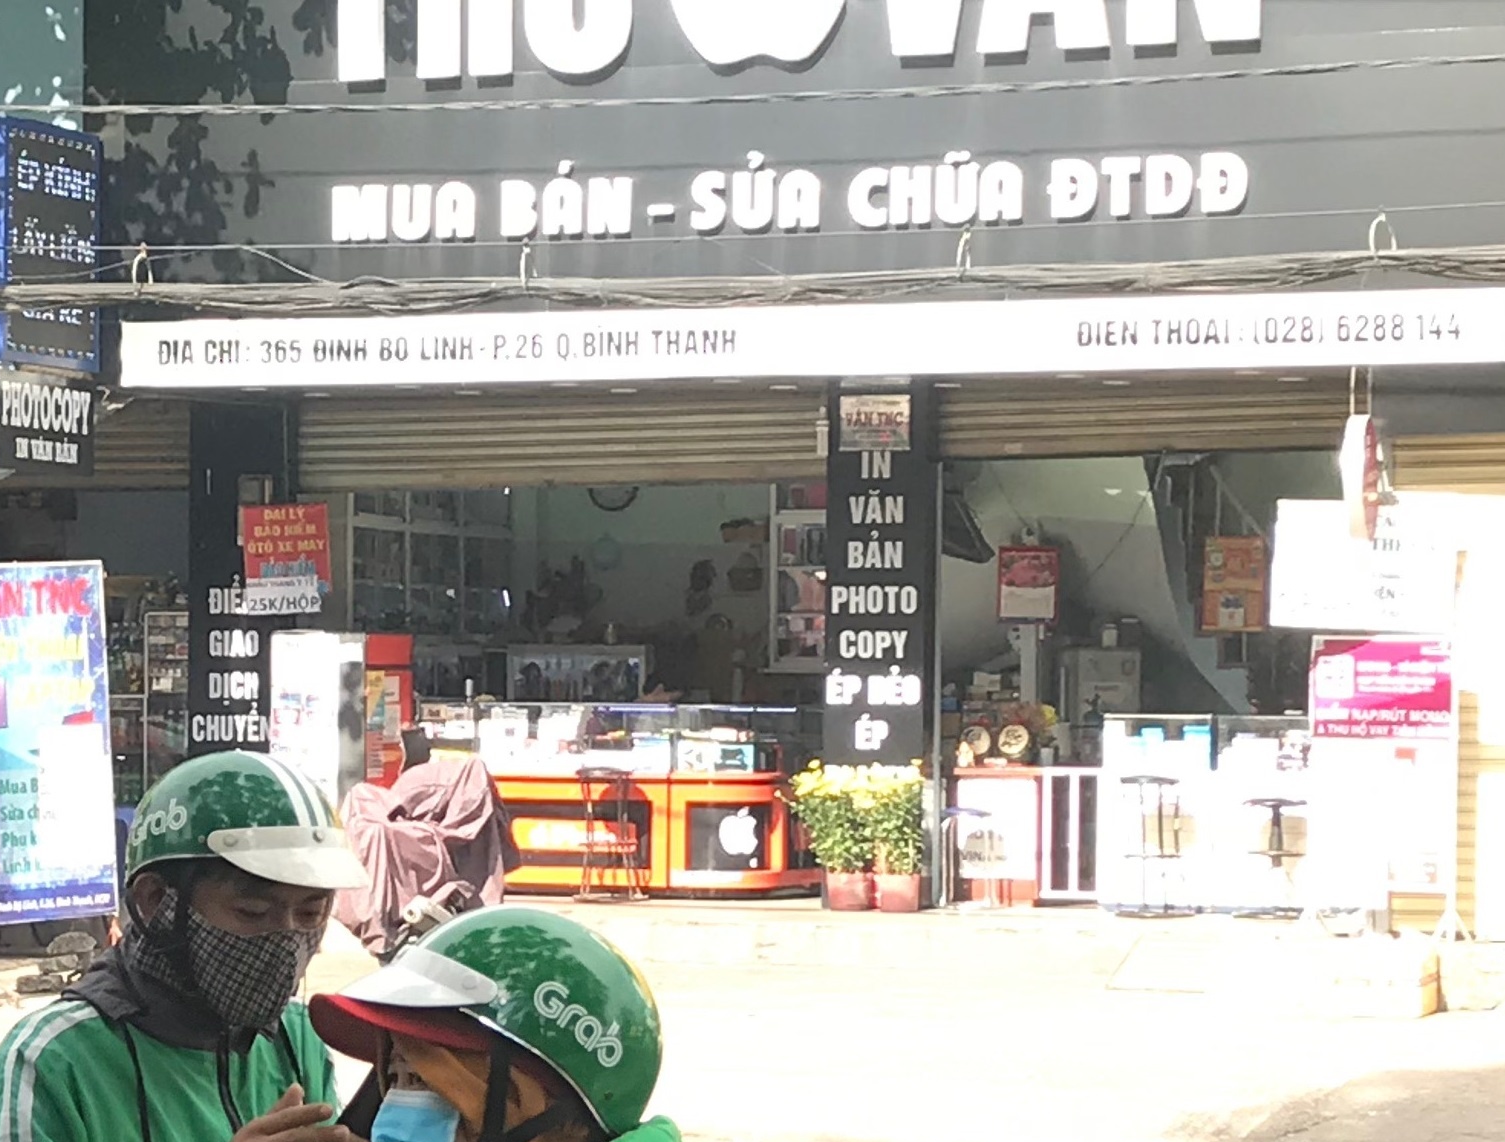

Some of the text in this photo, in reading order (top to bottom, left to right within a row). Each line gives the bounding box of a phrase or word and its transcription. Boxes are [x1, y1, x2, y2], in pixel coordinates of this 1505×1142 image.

[331, 180, 477, 242] MUA
[500, 160, 633, 238] BÁN
[690, 150, 821, 233] SỬA
[847, 150, 1024, 228] CHỮA
[1046, 151, 1250, 220] ĐTDĐ
[1337, 314, 1405, 344] 6288
[260, 340, 302, 364] 365
[0, 379, 92, 436] PHOTOCOPY
[15, 436, 29, 460] IN
[860, 450, 892, 480] IN
[848, 488, 905, 525] VĂN
[277, 541, 294, 553] XE
[846, 529, 904, 569] BẢN
[30, 576, 93, 618] TNC
[207, 573, 249, 614] ĐIỂ
[249, 593, 321, 614] 25K/HỘP
[830, 584, 919, 615] PHOTO
[208, 628, 260, 658] GIAO
[839, 629, 909, 660] COPY
[208, 671, 260, 706] DỊCH
[825, 666, 863, 706] ÉP
[854, 712, 889, 751] ÉP
[0, 779, 27, 795] Mua
[130, 797, 188, 847] Grab
[533, 980, 624, 1068] Grab
